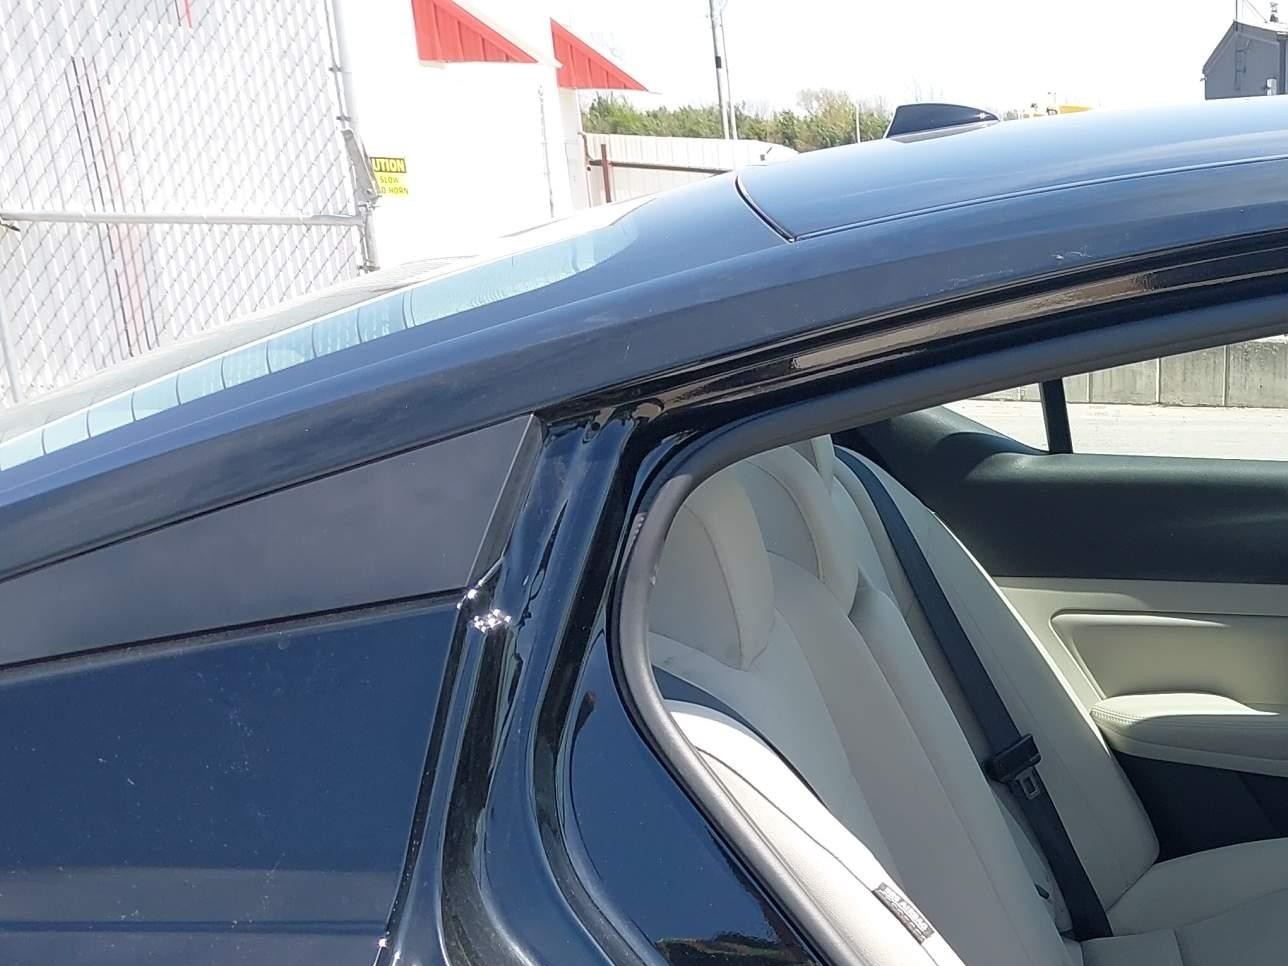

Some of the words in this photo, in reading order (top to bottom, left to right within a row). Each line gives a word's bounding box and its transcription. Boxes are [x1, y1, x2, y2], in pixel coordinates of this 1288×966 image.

[372, 158, 405, 172] UTION
[379, 176, 399, 184] SLOW
[388, 187, 409, 195] HORN
